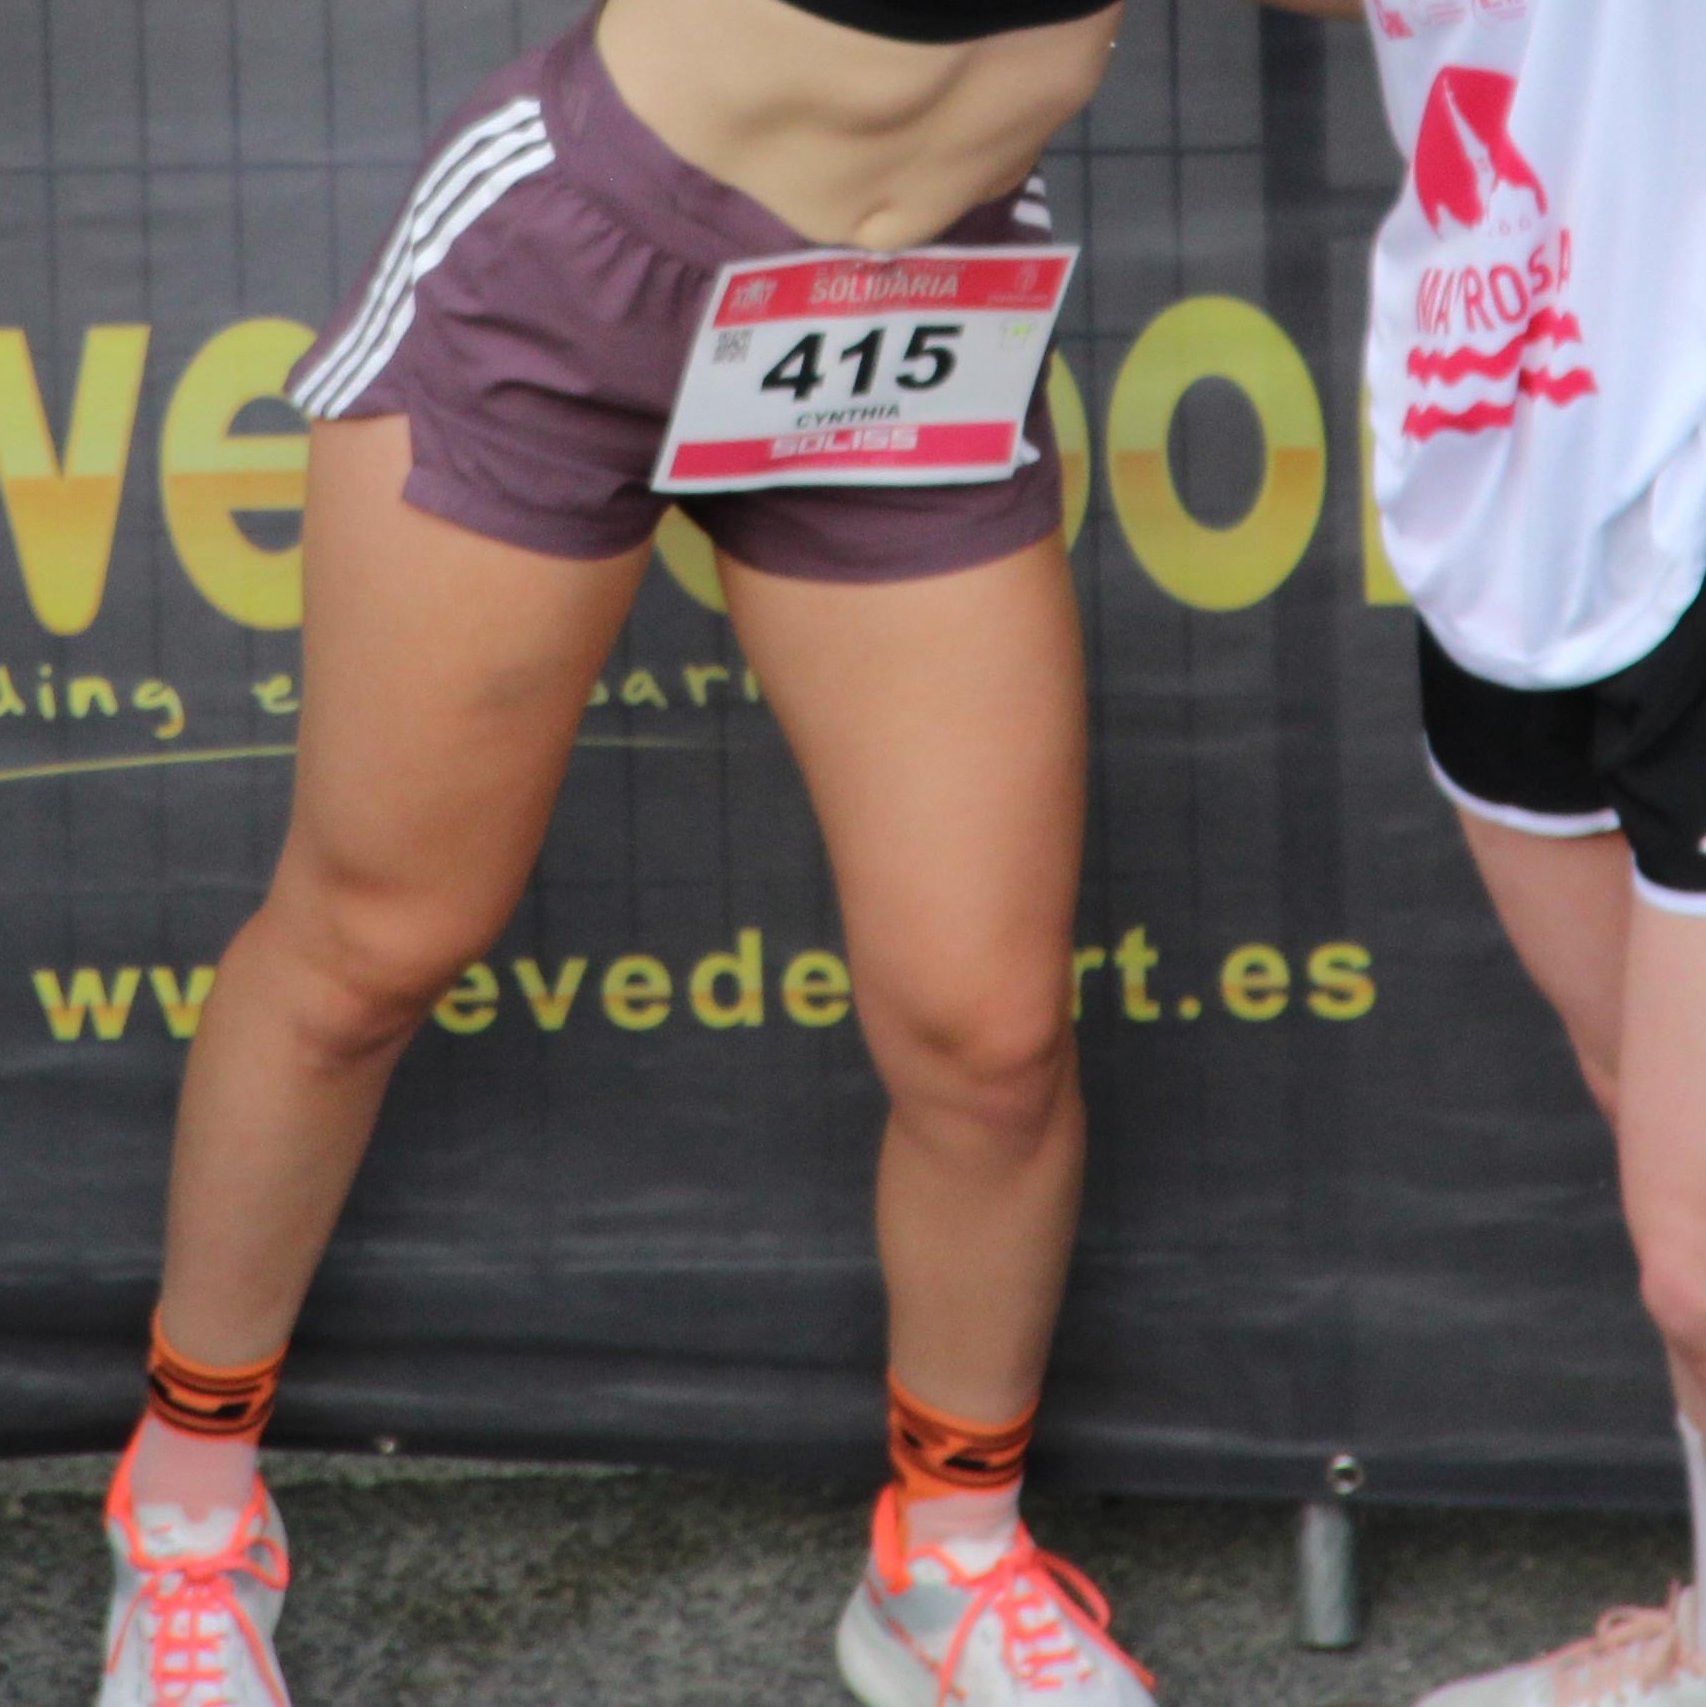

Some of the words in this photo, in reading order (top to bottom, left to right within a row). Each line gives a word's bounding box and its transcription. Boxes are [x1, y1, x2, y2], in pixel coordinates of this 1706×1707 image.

[809, 272, 959, 304] SOLIDARIA
[760, 323, 966, 401] 415
[796, 404, 901, 428] CYNTHIA
[771, 425, 919, 458] SOLISS
